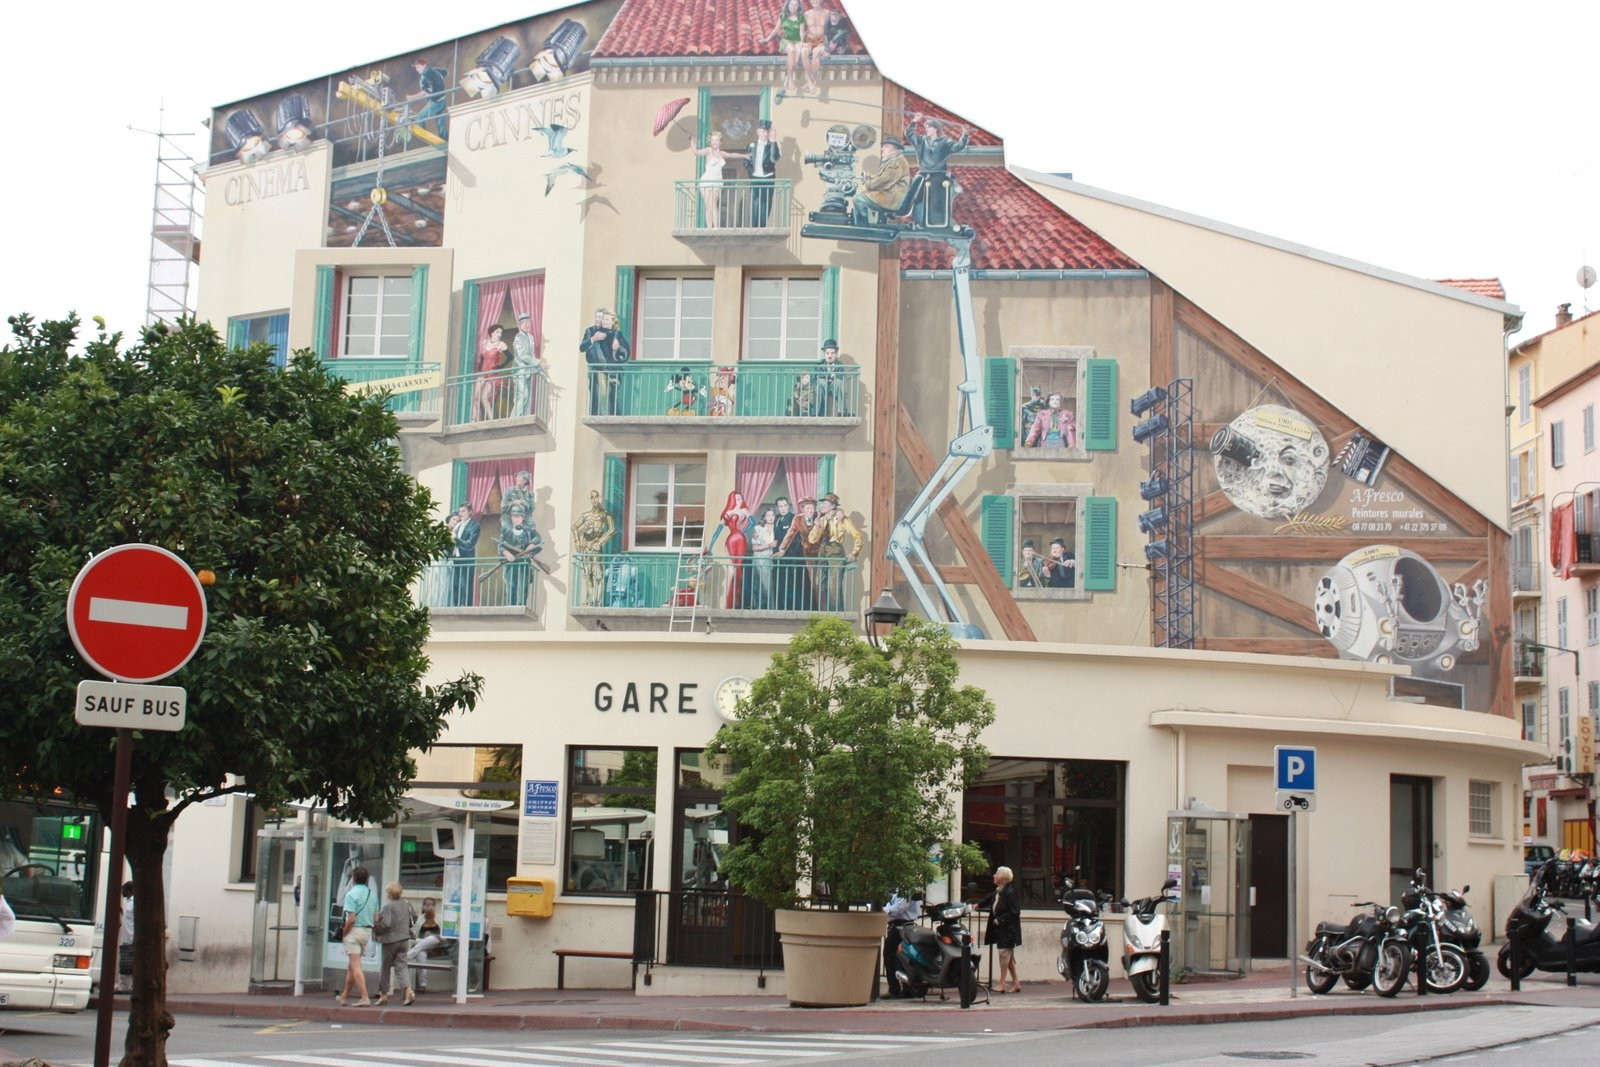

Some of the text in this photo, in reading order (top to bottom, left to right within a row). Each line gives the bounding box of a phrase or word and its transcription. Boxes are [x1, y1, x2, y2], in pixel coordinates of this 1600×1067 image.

[464, 91, 581, 151] CANNES
[224, 158, 311, 206] CINEMA
[1350, 488, 1404, 507] A.Fresco
[1352, 507, 1423, 518] Peintures murales
[1361, 523, 1368, 531] 77
[1376, 523, 1384, 531] 23
[1384, 523, 1392, 531] 70
[1411, 523, 1418, 531] 22
[84, 695, 180, 717] SAUF BUS
[594, 681, 698, 714] GARE
[1581, 717, 1591, 772] COYOTE
[1287, 755, 1305, 782] P
[68, 828, 74, 838] 1
[58, 938, 75, 947] 320
